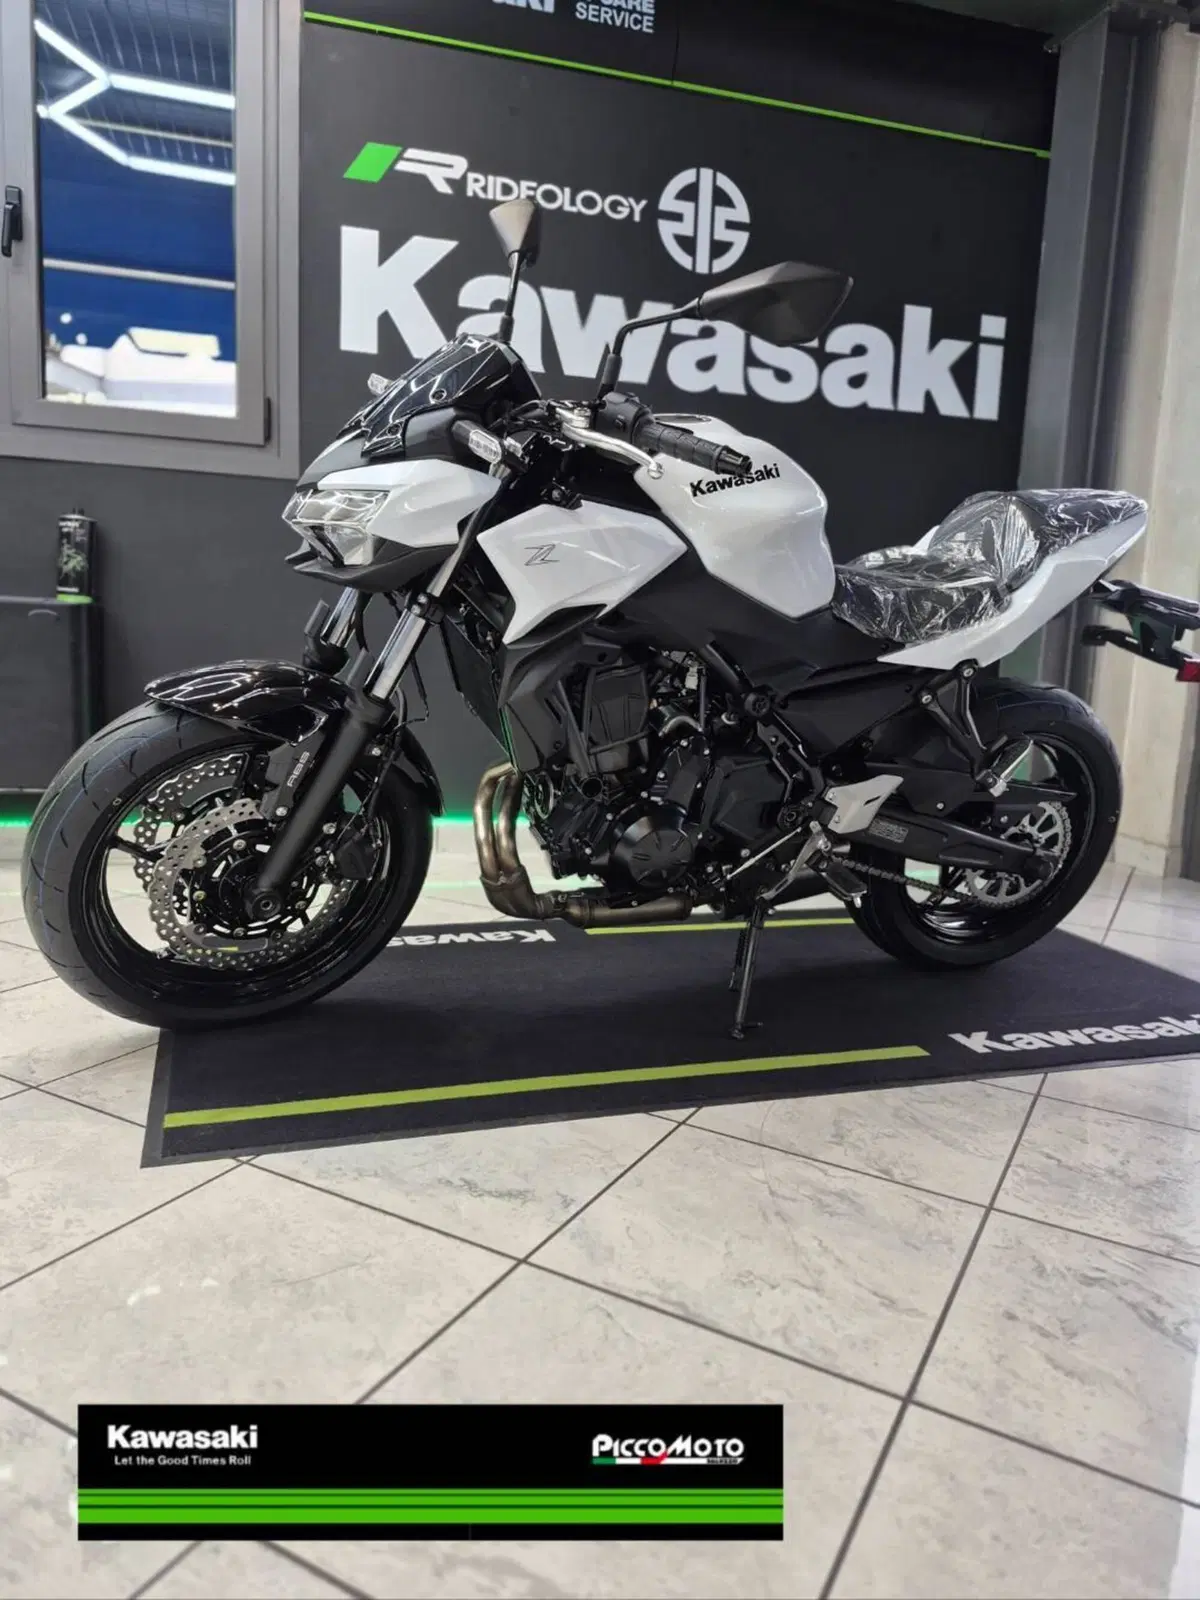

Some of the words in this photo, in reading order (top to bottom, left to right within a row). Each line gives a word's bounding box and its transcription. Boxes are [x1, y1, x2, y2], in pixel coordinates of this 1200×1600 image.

[575, 2, 654, 33] SERVICE
[340, 225, 1007, 421] Kawasaki
[690, 463, 781, 497] Kawasaki
[948, 1013, 1200, 1054] Kawasak
